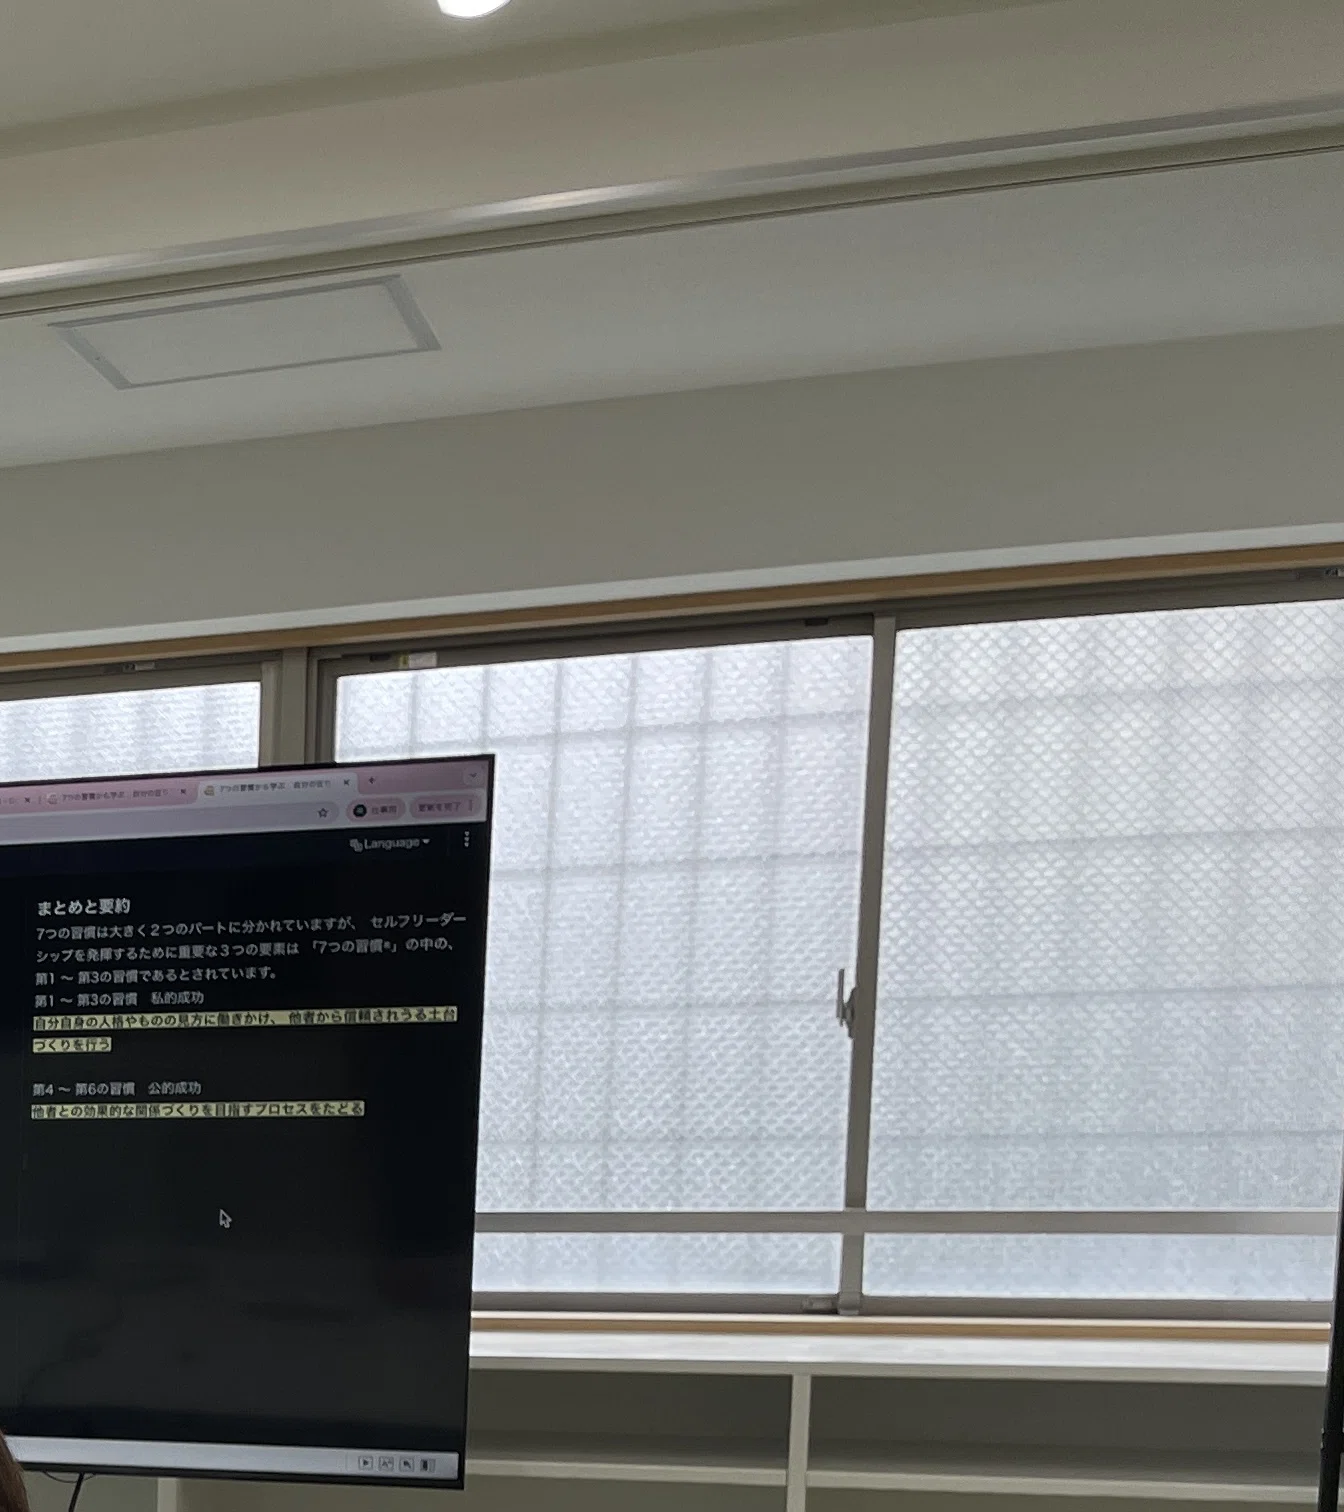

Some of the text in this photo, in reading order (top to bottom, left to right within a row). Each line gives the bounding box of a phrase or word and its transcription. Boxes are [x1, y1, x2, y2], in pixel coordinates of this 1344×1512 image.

[364, 837, 420, 850] Language
[38, 898, 131, 916] まとめと要約
